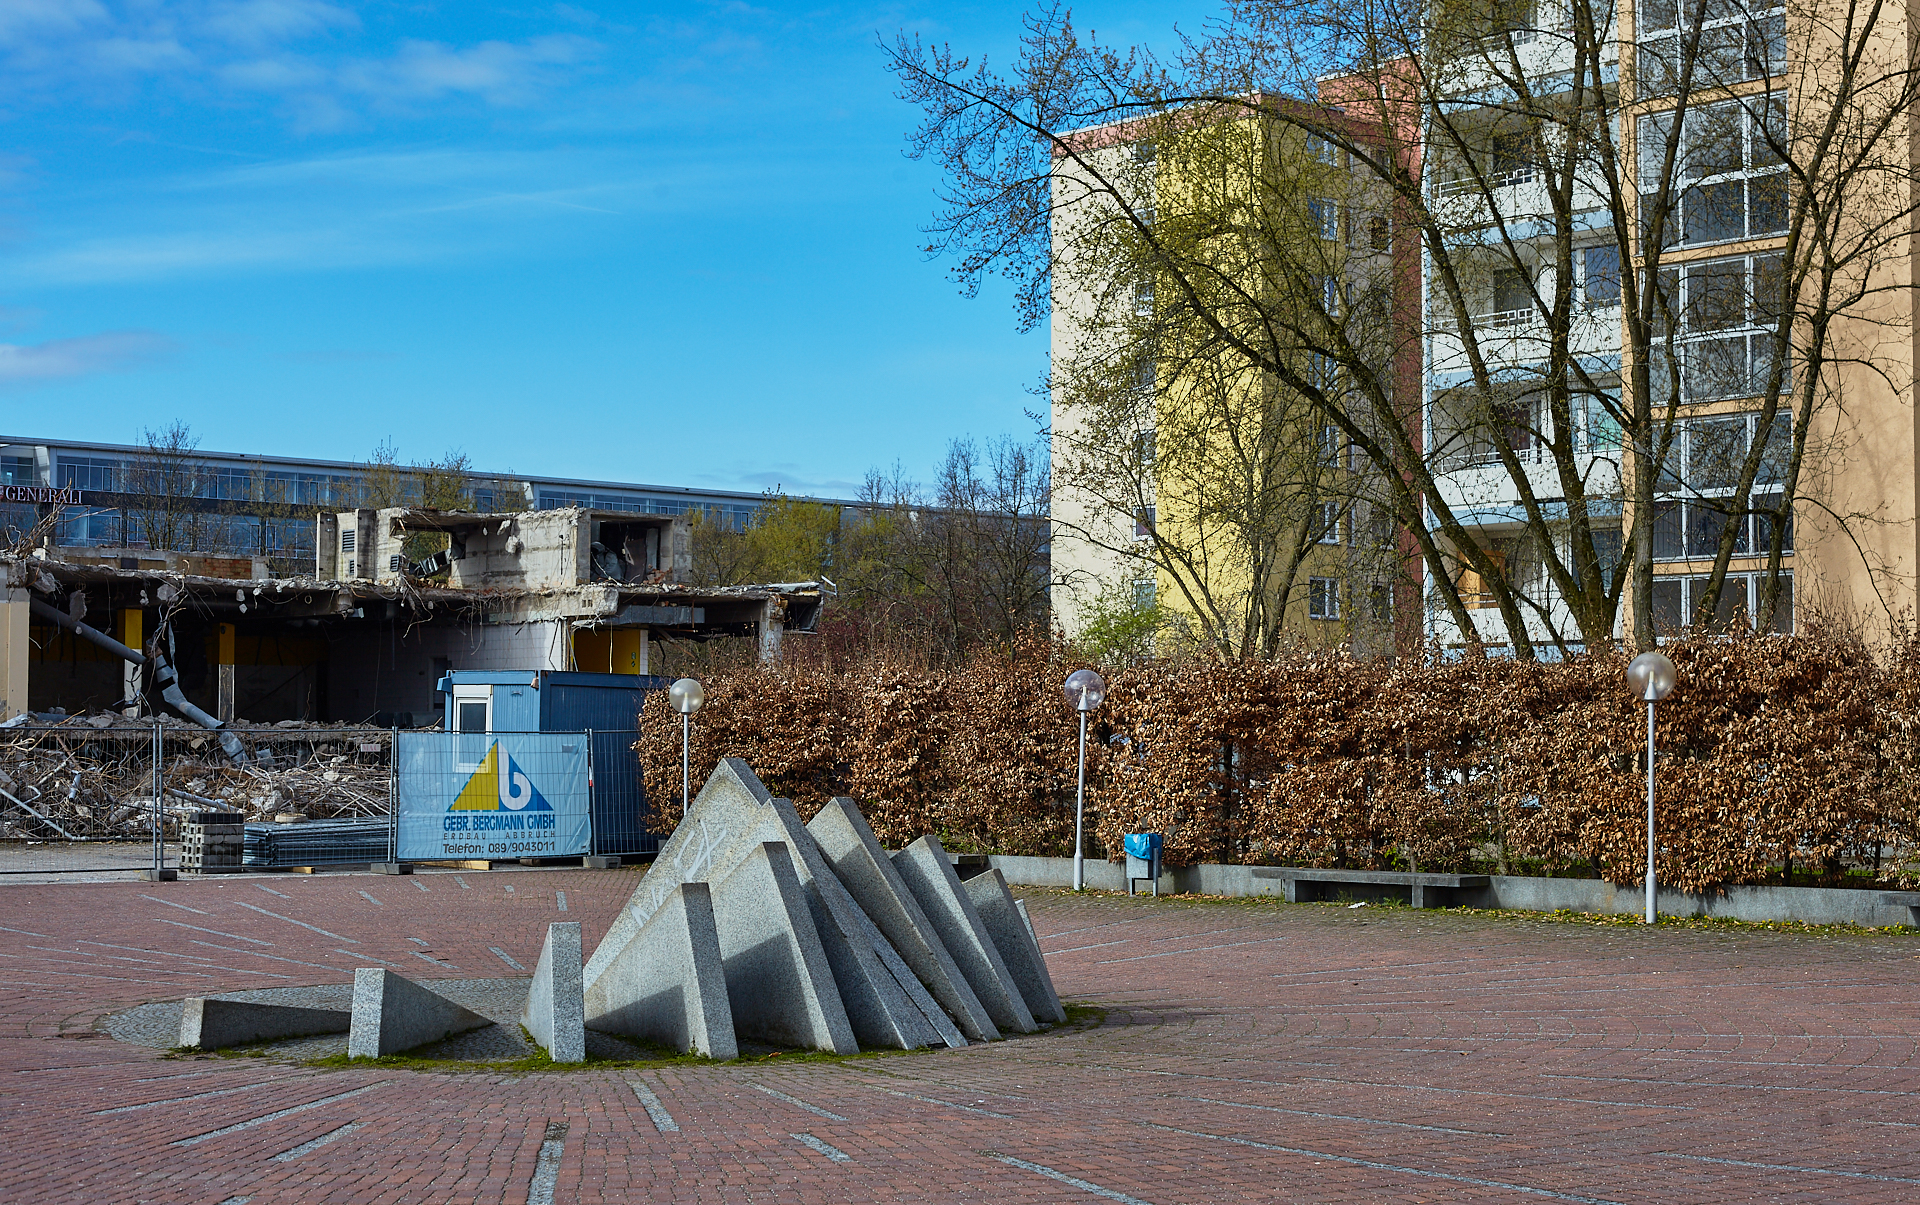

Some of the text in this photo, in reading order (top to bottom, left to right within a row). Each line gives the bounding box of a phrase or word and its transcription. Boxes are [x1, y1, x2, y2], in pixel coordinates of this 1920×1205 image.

[5, 486, 83, 504] GENERALI
[443, 813, 556, 831] GEBR. BERGMANN GMBH
[443, 830, 556, 840] ERDBAU ABBRUCH
[443, 841, 556, 854] Telefon: 089/9043011
